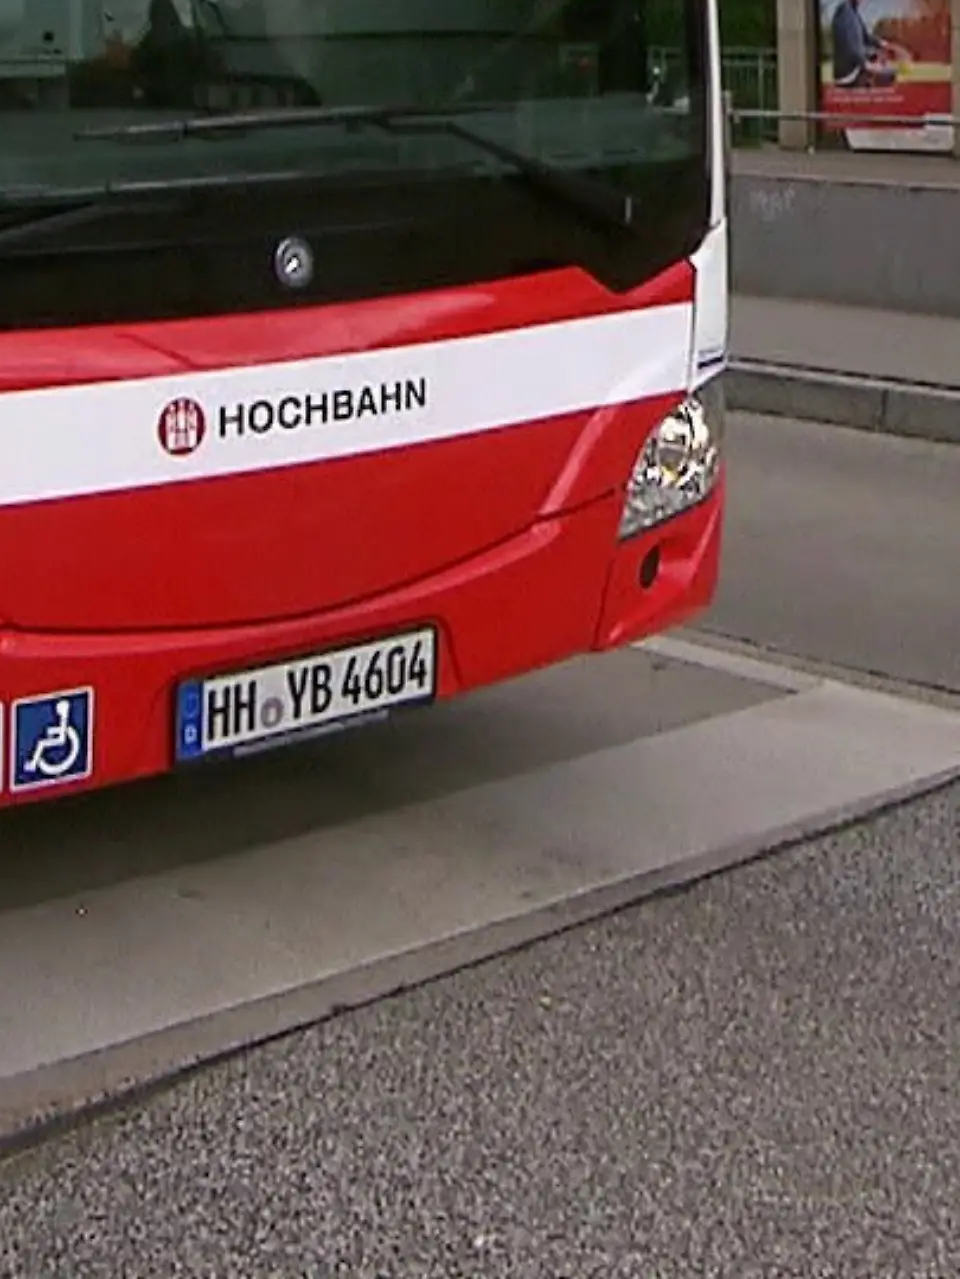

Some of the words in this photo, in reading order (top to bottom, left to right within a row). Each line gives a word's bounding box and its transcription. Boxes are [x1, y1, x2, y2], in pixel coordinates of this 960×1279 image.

[218, 377, 427, 437] HOCHBAHN
[207, 680, 257, 741] HH
[286, 665, 332, 719] YB
[341, 640, 428, 704] 4604
